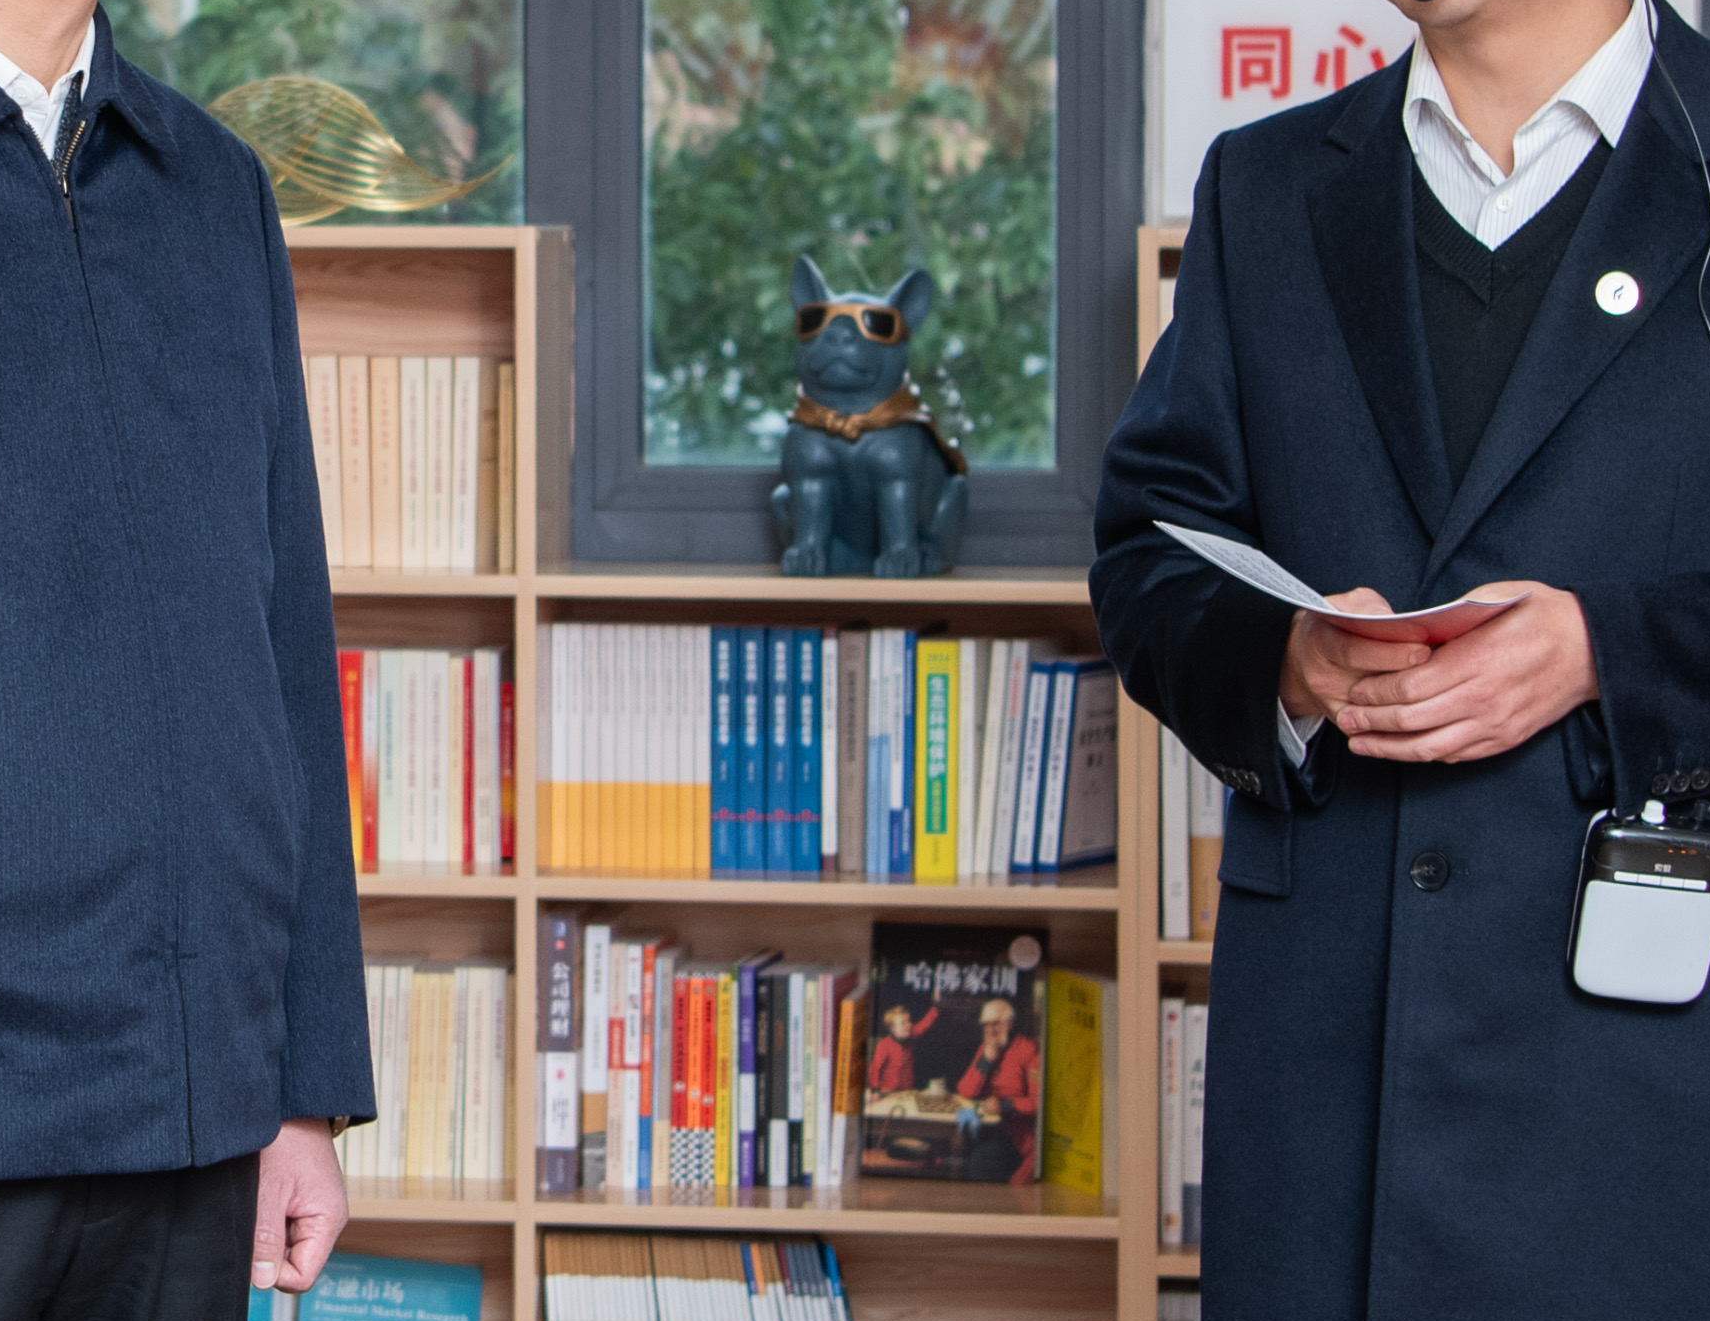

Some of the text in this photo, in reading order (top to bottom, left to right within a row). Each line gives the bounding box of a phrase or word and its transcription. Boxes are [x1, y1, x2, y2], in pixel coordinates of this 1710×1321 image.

[1221, 23, 1386, 100] 同心
[928, 675, 948, 780] 生态环境保护
[550, 960, 572, 1039] 公司理财
[903, 960, 1020, 998] 哈佛家训
[314, 1299, 368, 1317] Financial
[371, 1303, 414, 1320] Market
